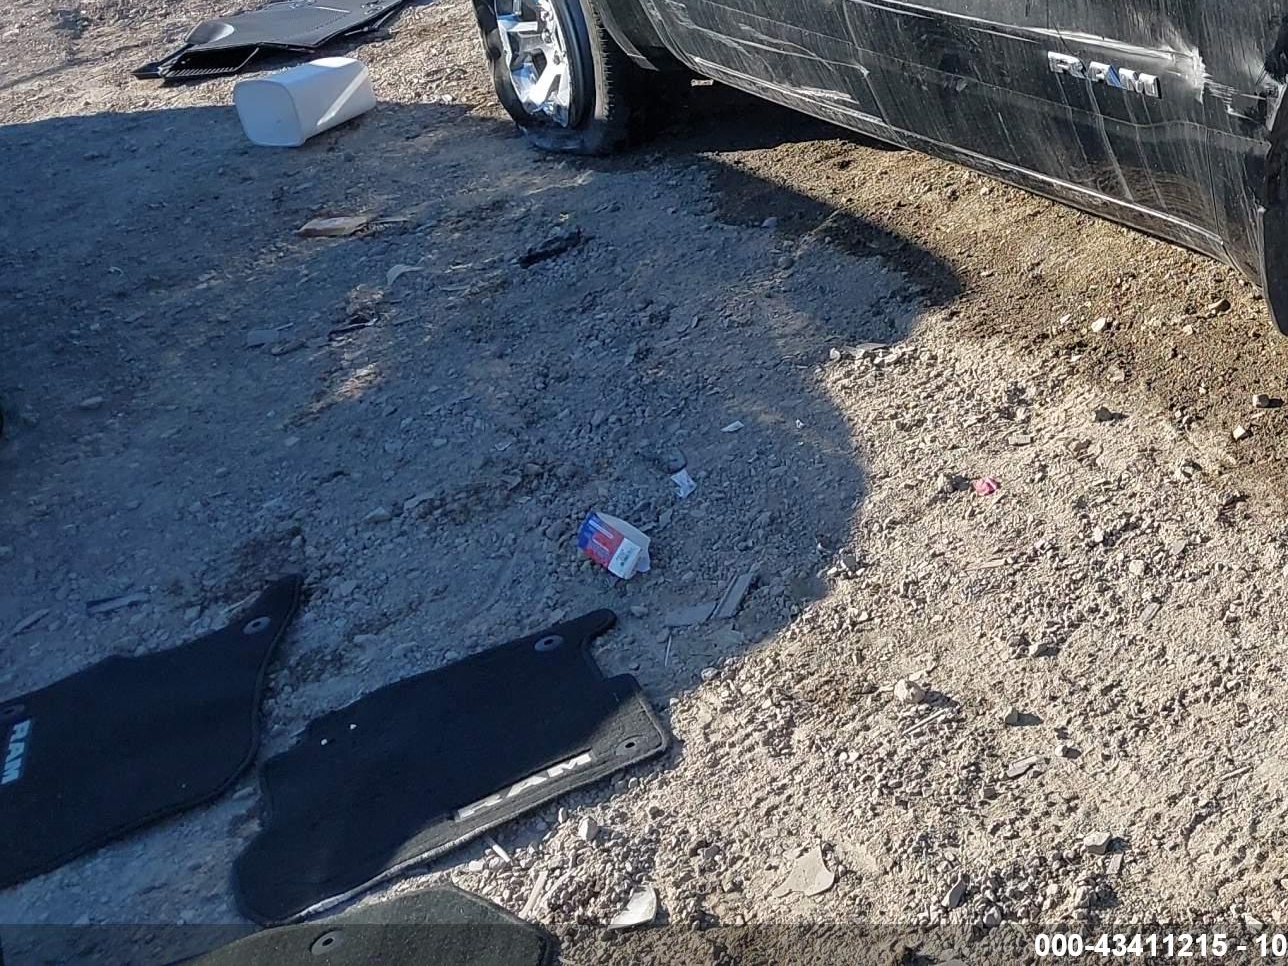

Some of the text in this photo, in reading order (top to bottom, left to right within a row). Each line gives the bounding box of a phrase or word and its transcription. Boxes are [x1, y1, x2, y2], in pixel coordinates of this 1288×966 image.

[1047, 51, 1160, 98] RAM
[1, 720, 31, 785] RAM
[457, 752, 592, 821] RAM
